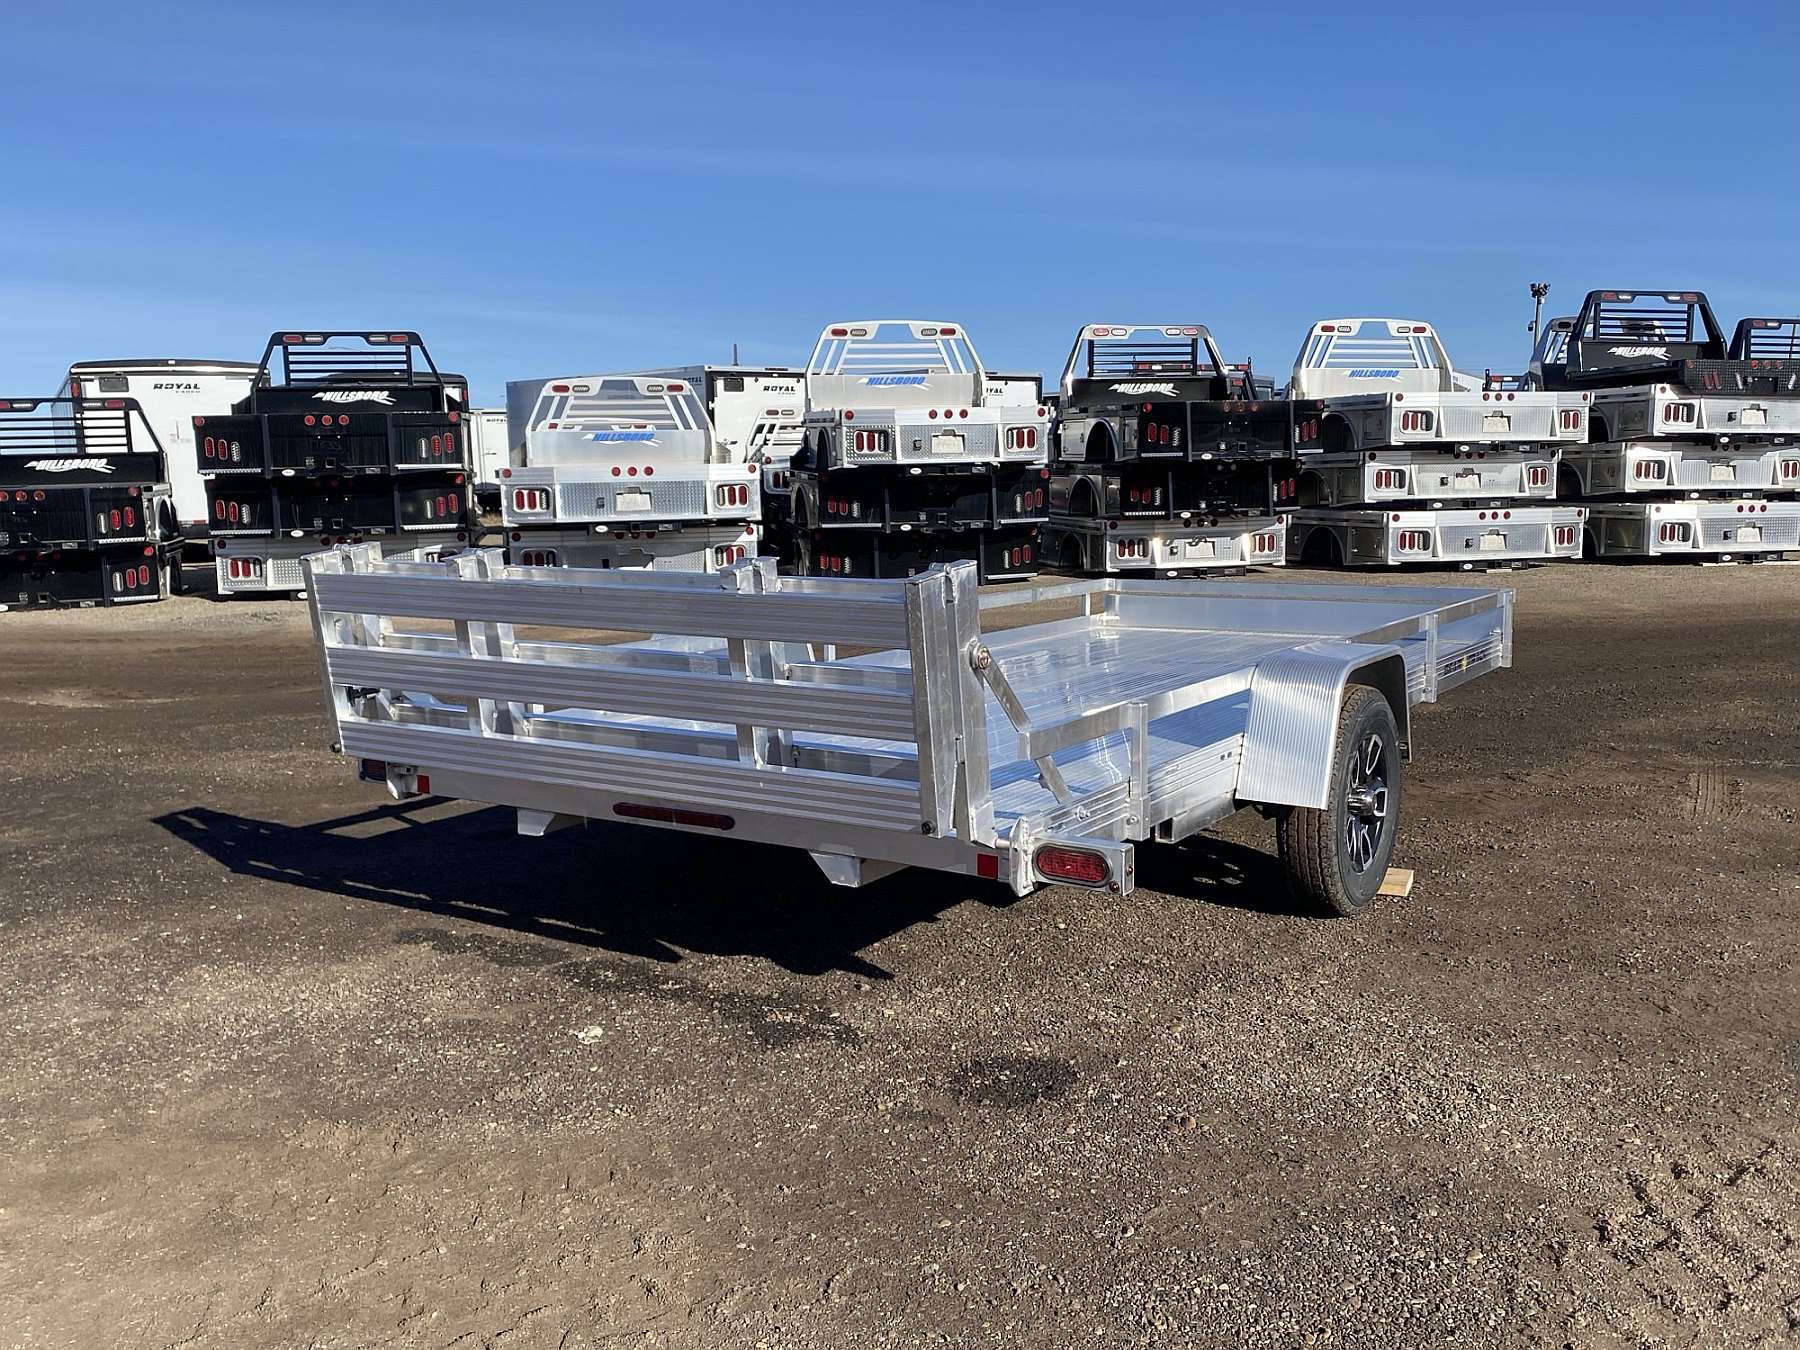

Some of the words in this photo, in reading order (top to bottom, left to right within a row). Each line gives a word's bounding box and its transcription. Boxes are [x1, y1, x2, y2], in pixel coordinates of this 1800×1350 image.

[1615, 346, 1667, 358] HILLSBORO
[1348, 369, 1400, 378] HILLSBORO
[865, 376, 926, 386] HILLSBORO
[1117, 383, 1174, 394] HILLSBORO
[322, 391, 389, 402] HILLSBORO
[592, 432, 655, 442] HILLSBORO
[36, 458, 107, 471] HILLSBORO
